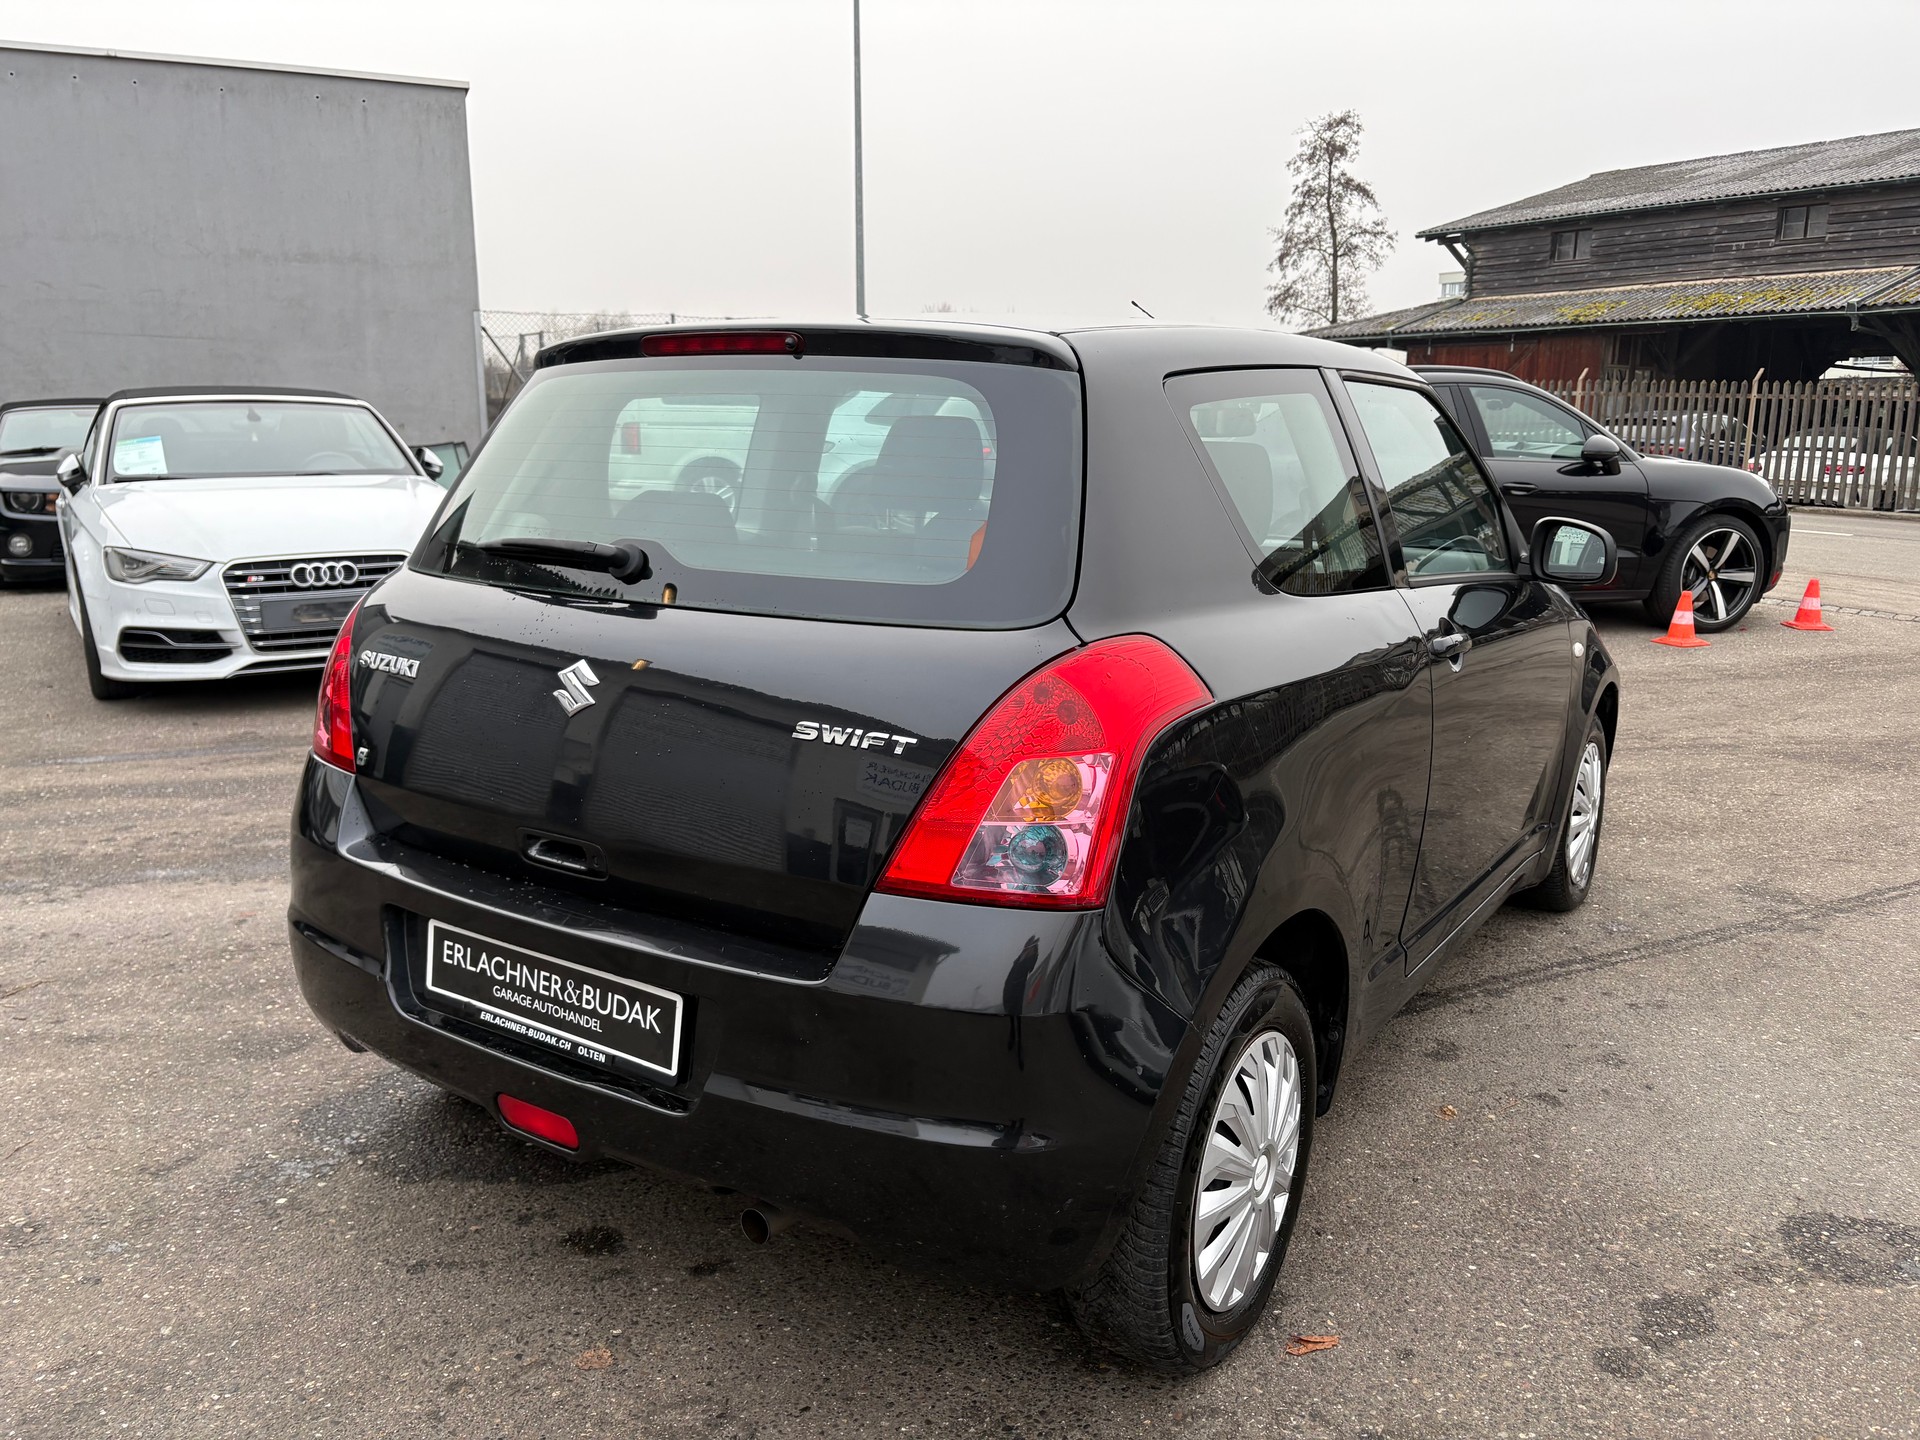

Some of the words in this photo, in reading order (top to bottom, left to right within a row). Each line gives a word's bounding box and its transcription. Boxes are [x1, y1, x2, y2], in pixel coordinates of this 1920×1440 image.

[360, 650, 420, 678] SUZUKI
[792, 720, 918, 755] SWIFT
[443, 940, 661, 1034] ERLACHNER&BUDAK
[493, 986, 531, 1008] GARAGE
[532, 1001, 602, 1032] AUTOHANDEL
[480, 1011, 571, 1051] ERLACHNER-BUDAK.CH
[577, 1046, 606, 1063] OLTEN
